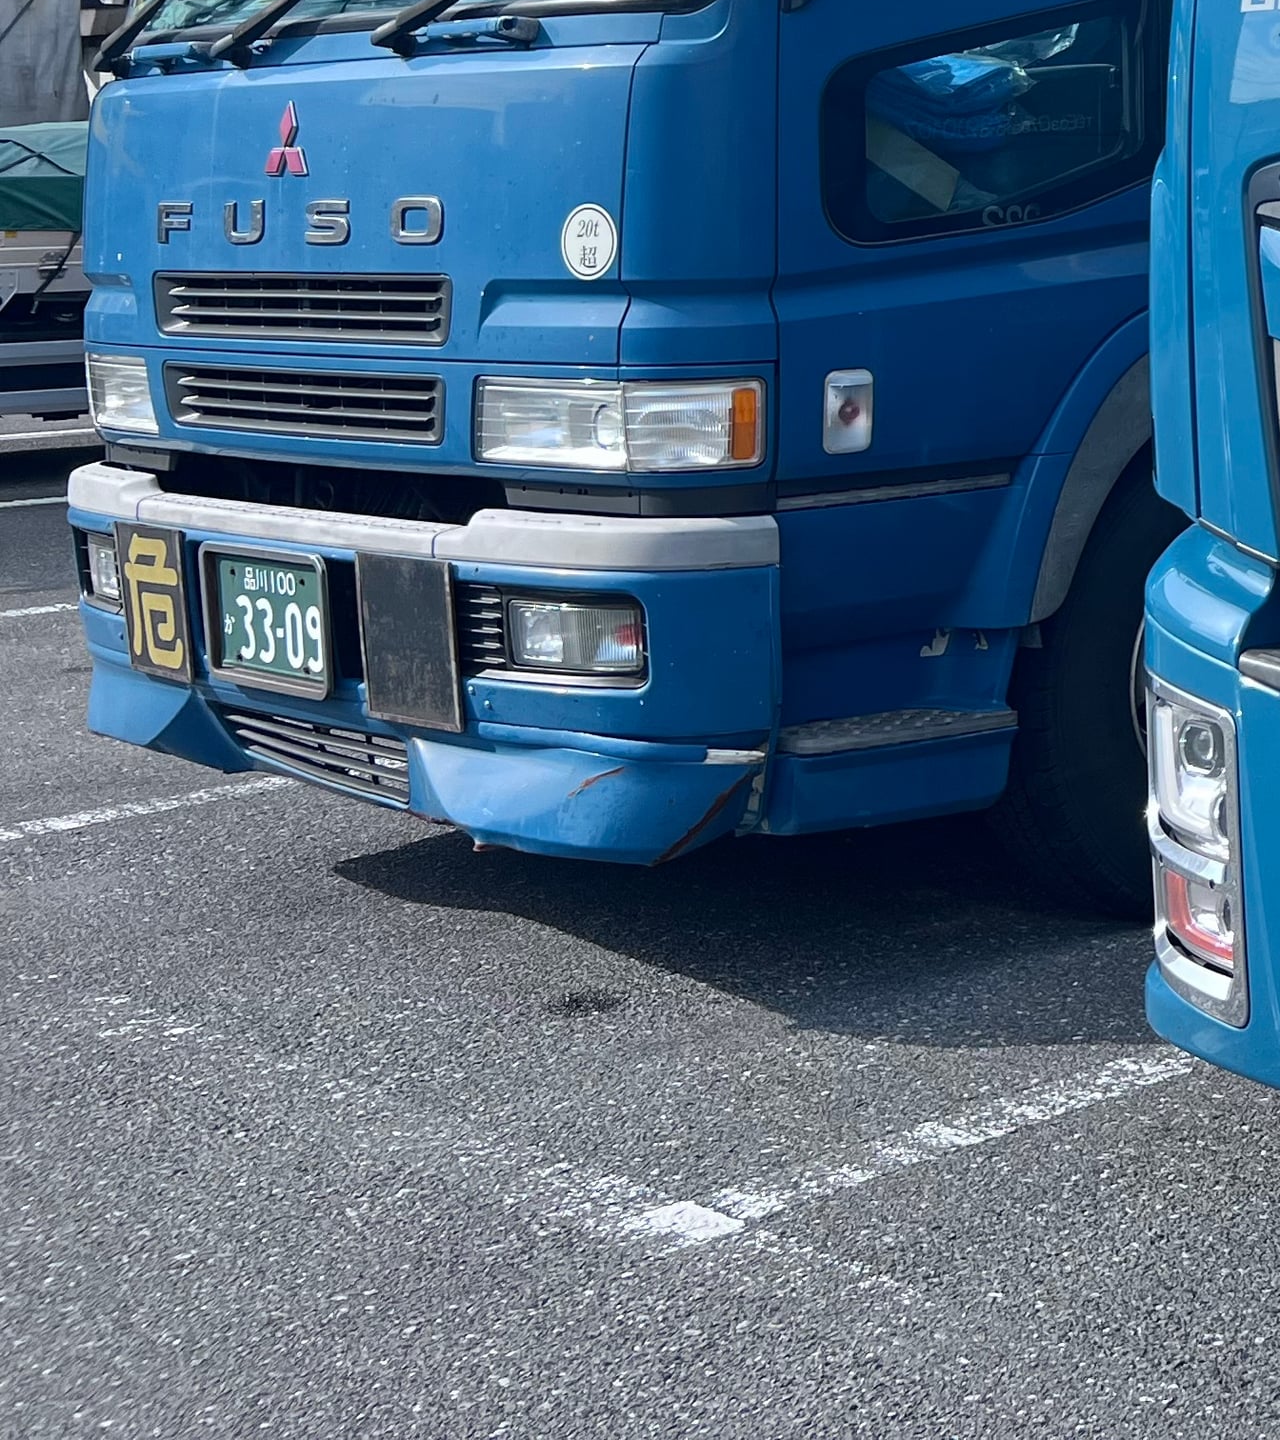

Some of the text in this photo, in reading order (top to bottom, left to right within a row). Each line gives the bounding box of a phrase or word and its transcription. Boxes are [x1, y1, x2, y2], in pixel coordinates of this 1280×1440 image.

[156, 196, 444, 245] FUSO
[576, 219, 600, 238] 20t
[579, 245, 597, 269] 超
[124, 532, 184, 670] 危
[224, 594, 323, 673] か 33-09
